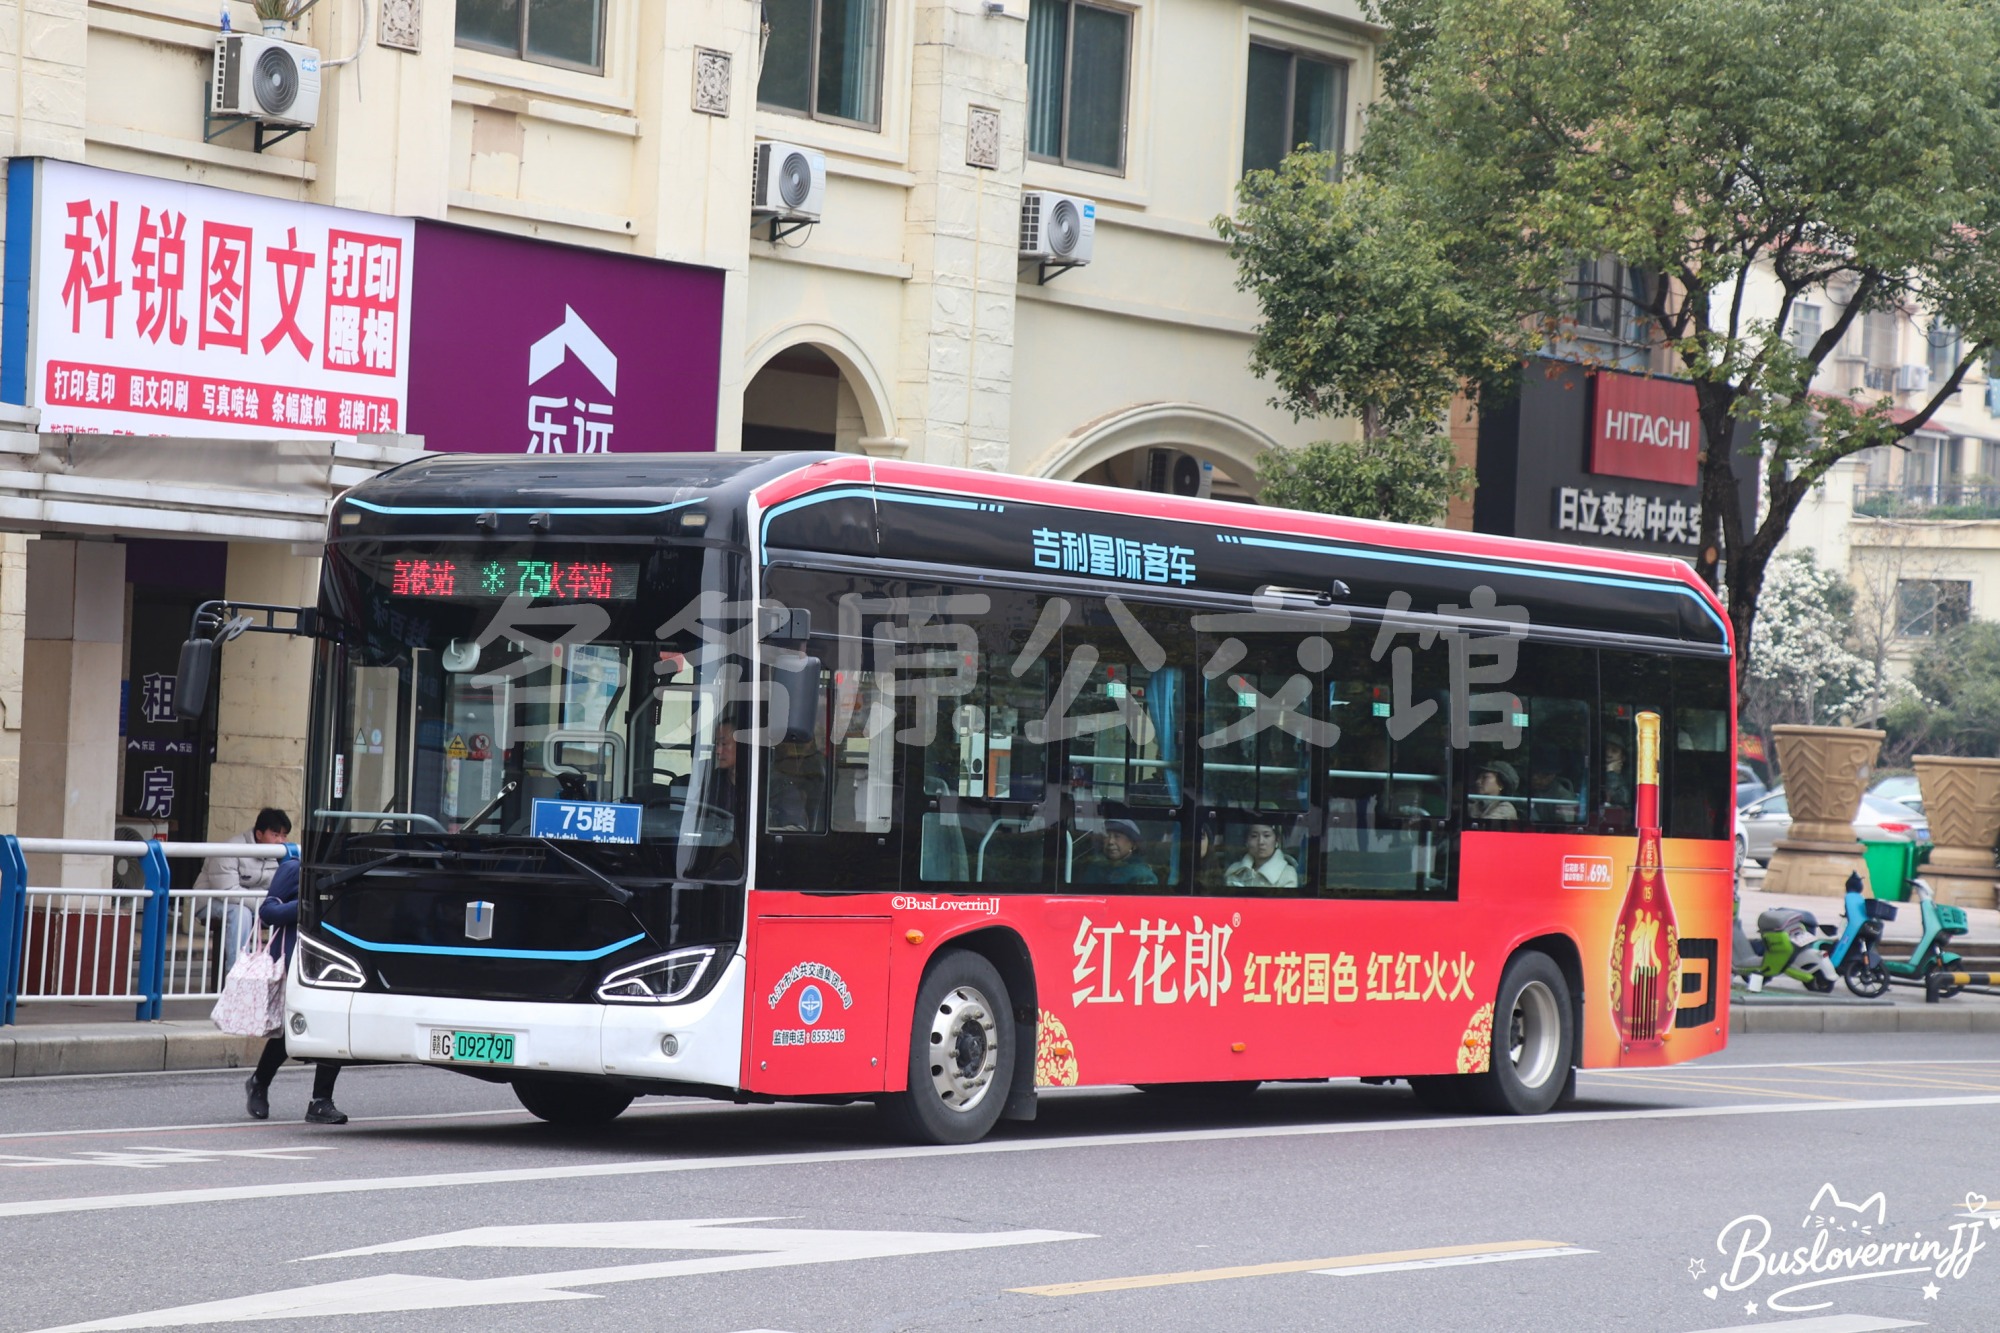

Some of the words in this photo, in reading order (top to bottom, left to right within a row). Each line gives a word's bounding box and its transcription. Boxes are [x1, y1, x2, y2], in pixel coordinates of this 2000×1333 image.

[61, 199, 316, 363] 科锐图文
[332, 239, 397, 302] 打印
[328, 304, 394, 370] 照相
[53, 367, 116, 405] 打印复印
[129, 375, 189, 413] 图文印刷
[202, 384, 259, 420] 写真喷绘
[271, 392, 327, 427] 条幅旗帜
[339, 398, 393, 434] 招牌门头
[1604, 409, 1690, 450] HITACHI
[1558, 486, 1726, 549] 日立变频中央空
[1032, 527, 1196, 585] 吉利星际客车
[560, 805, 616, 833] 75路
[1243, 951, 1359, 1005] 红花国色
[1366, 951, 1476, 1002] 红红火火
